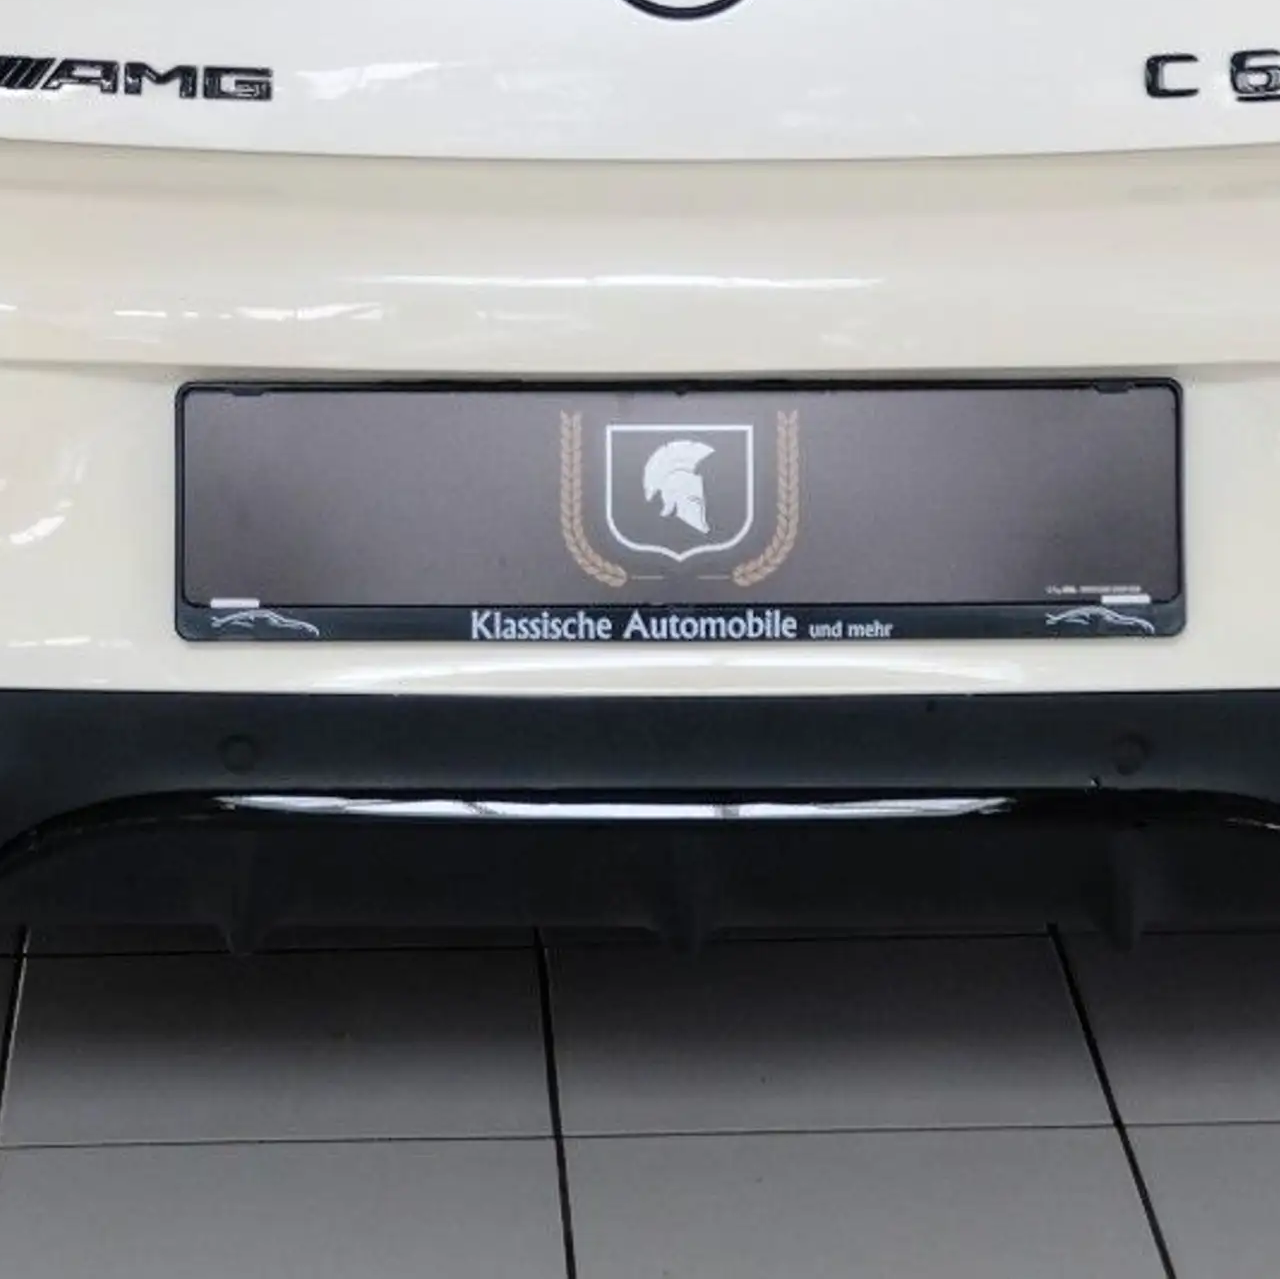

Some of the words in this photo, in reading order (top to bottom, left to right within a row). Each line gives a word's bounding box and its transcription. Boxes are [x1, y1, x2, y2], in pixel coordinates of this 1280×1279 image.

[40, 58, 273, 101] AMG
[1144, 52, 1199, 98] C
[470, 609, 612, 640] Klassische
[623, 609, 797, 639] Automobile
[808, 621, 842, 638] und
[847, 622, 893, 638] mehr
